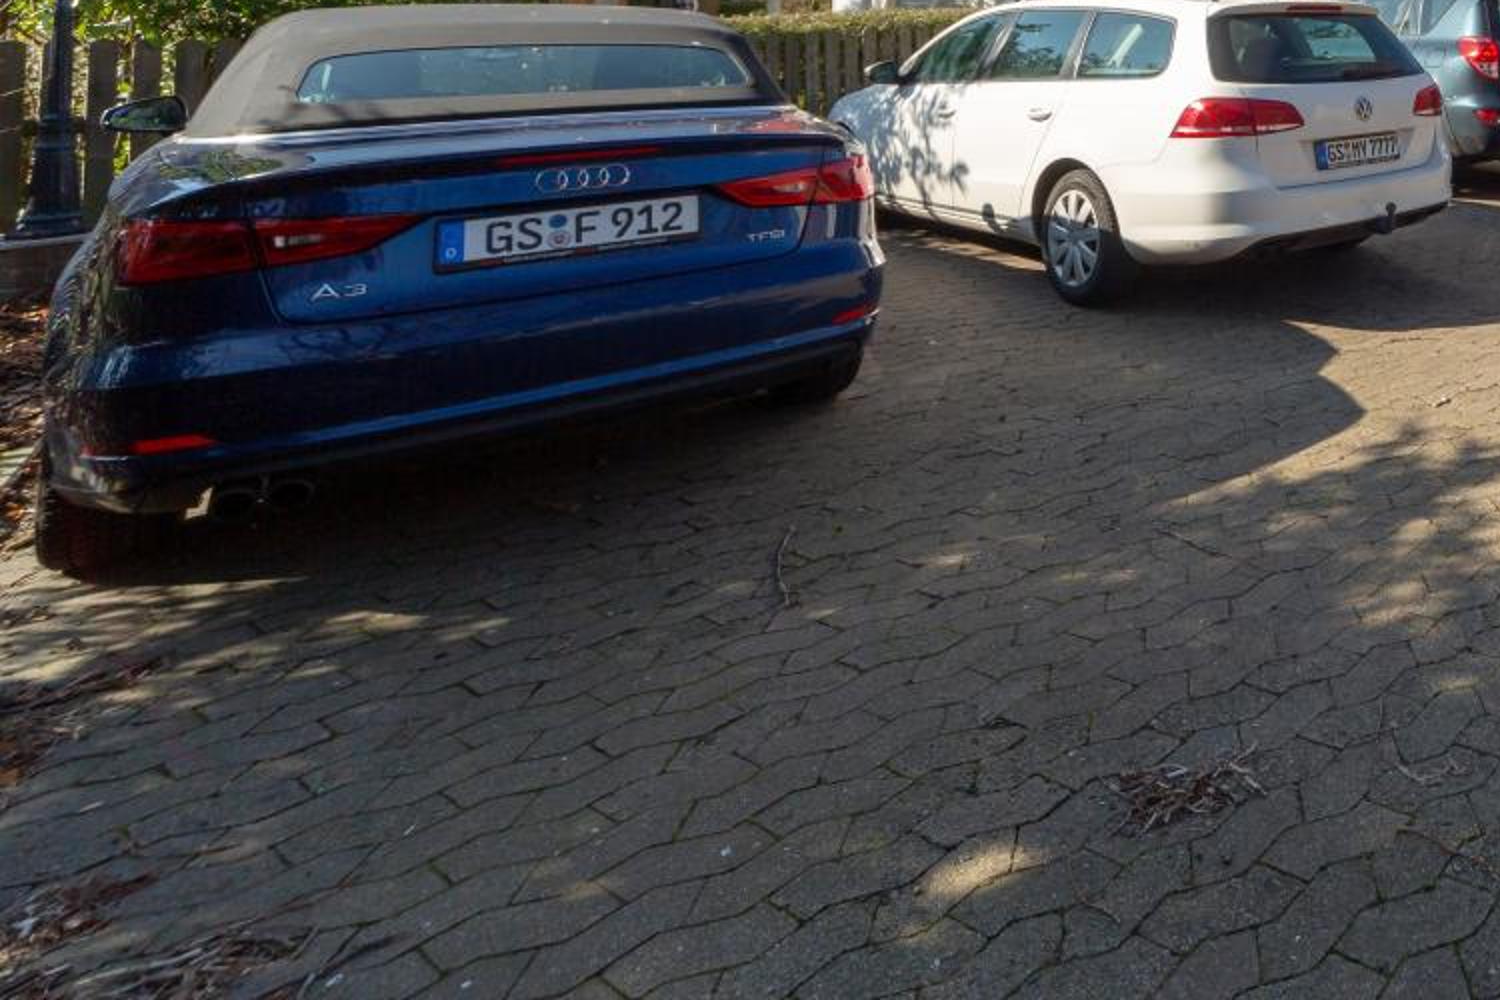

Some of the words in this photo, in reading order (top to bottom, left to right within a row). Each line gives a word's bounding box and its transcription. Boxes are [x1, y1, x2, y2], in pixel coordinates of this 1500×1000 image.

[486, 218, 543, 254] GS
[575, 211, 602, 243] F
[611, 201, 682, 238] 912
[310, 283, 367, 301] A3
